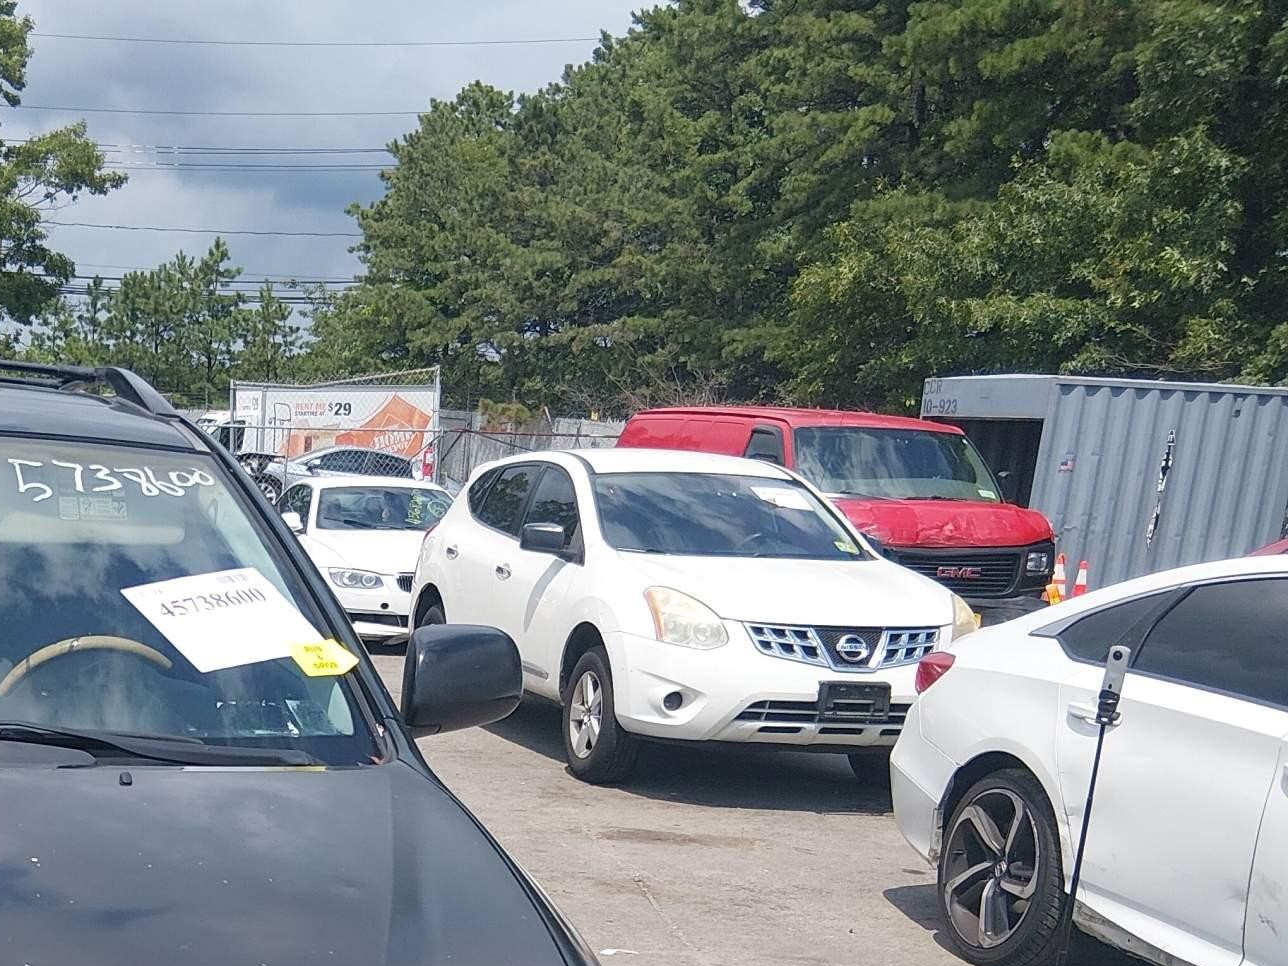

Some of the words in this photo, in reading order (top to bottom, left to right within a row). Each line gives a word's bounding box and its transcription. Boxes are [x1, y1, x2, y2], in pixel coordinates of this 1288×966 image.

[328, 401, 352, 417] $29
[922, 397, 958, 415] 10-923
[936, 566, 982, 578] GMC
[160, 586, 267, 618] 45738600
